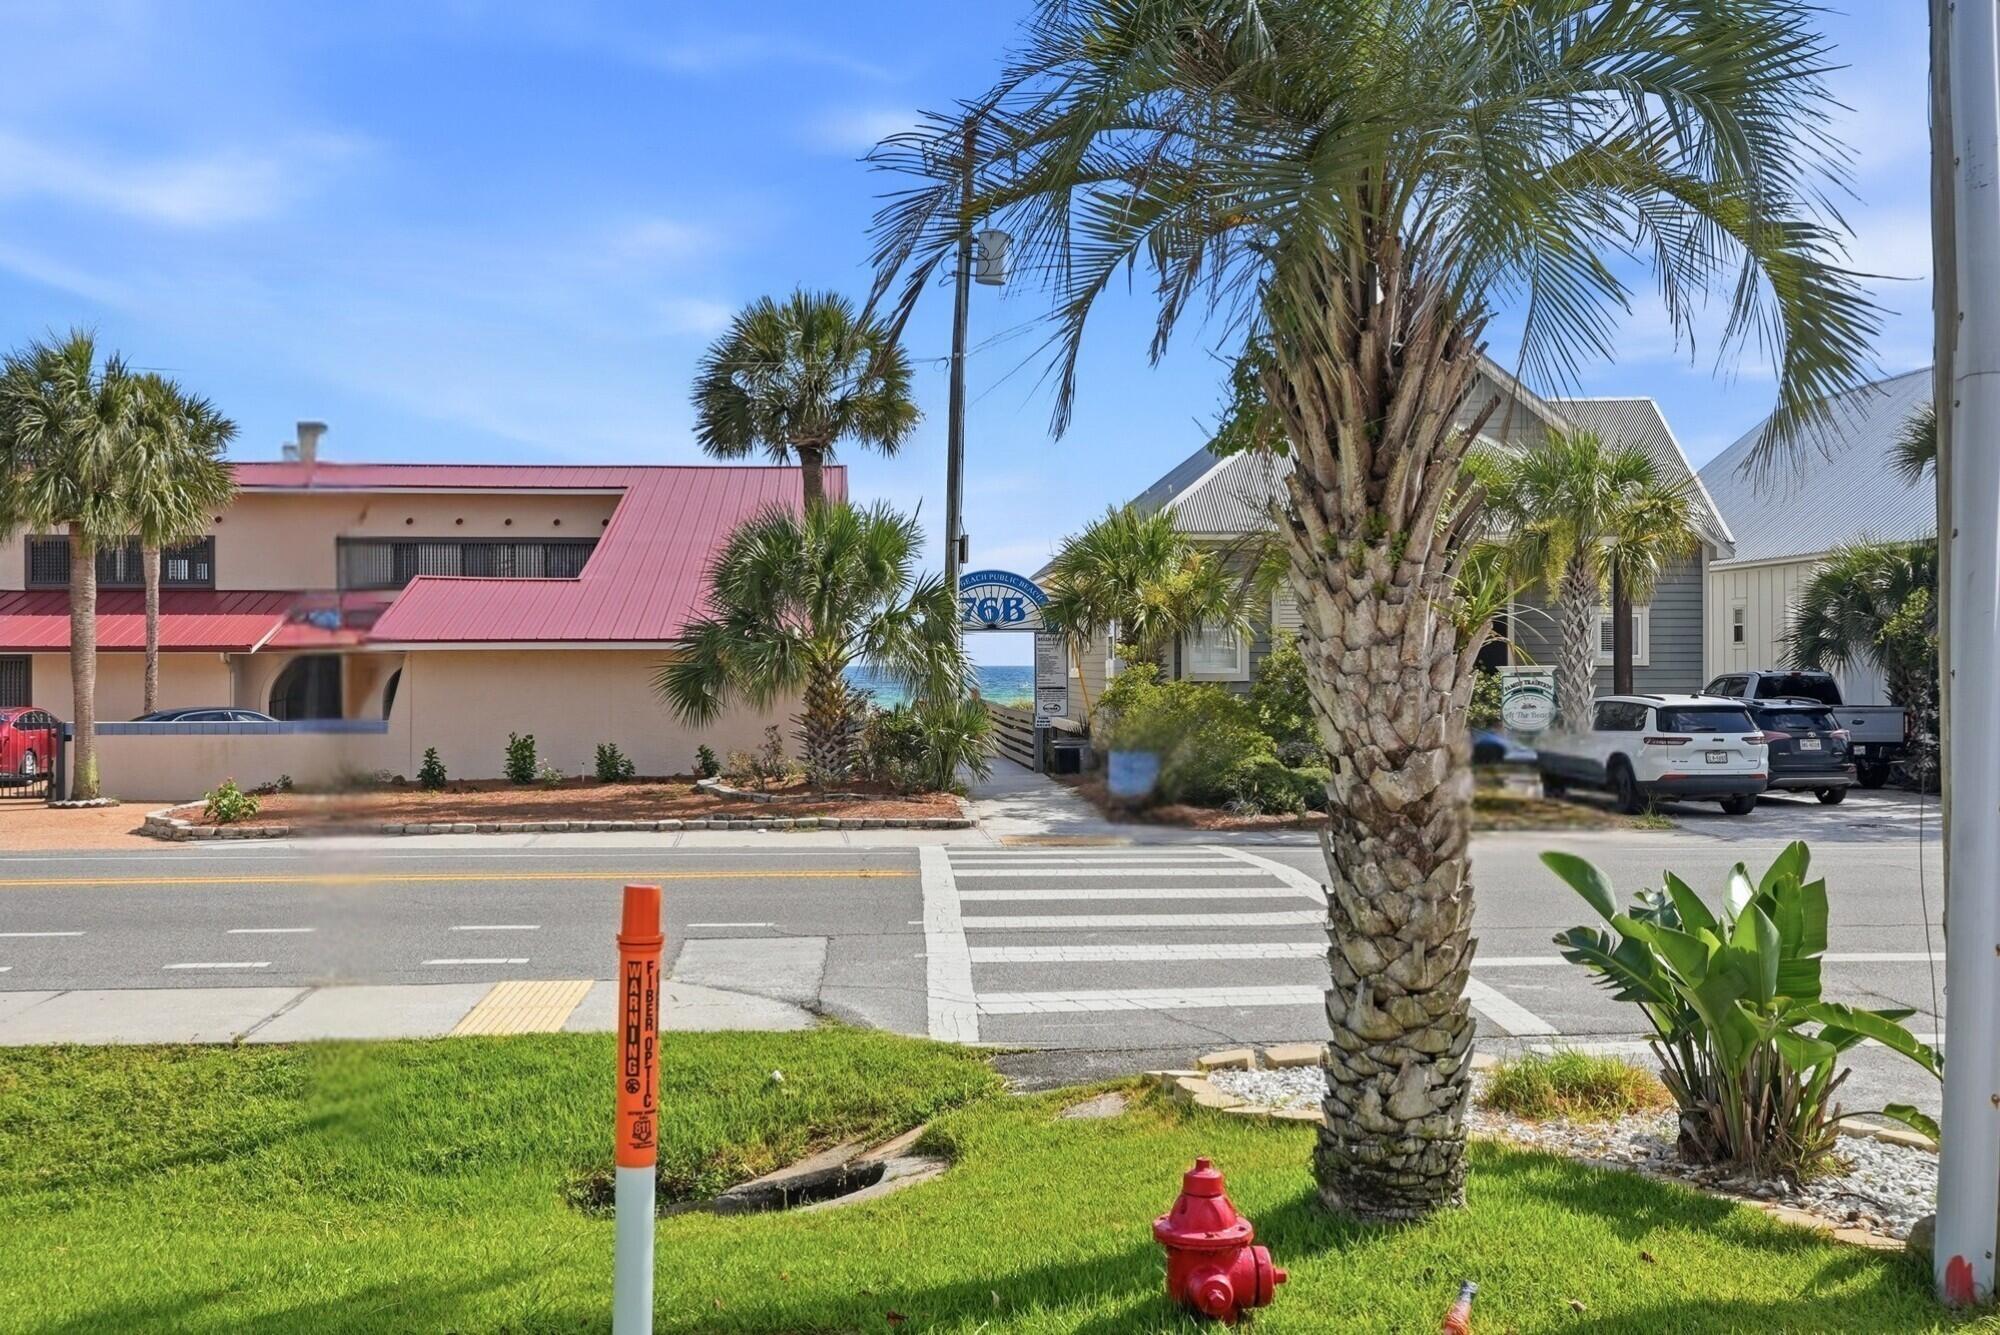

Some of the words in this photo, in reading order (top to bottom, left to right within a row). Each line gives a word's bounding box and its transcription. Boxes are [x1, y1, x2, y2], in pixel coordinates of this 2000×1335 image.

[959, 597, 1026, 622] 76B
[989, 573, 1019, 584] PUBLIC
[1018, 580, 1044, 601] BEACH
[627, 962, 641, 1076] WARNING
[645, 961, 654, 1032] FIBER
[644, 1036, 653, 1108] OPTIC
[634, 1122, 650, 1135] 811
